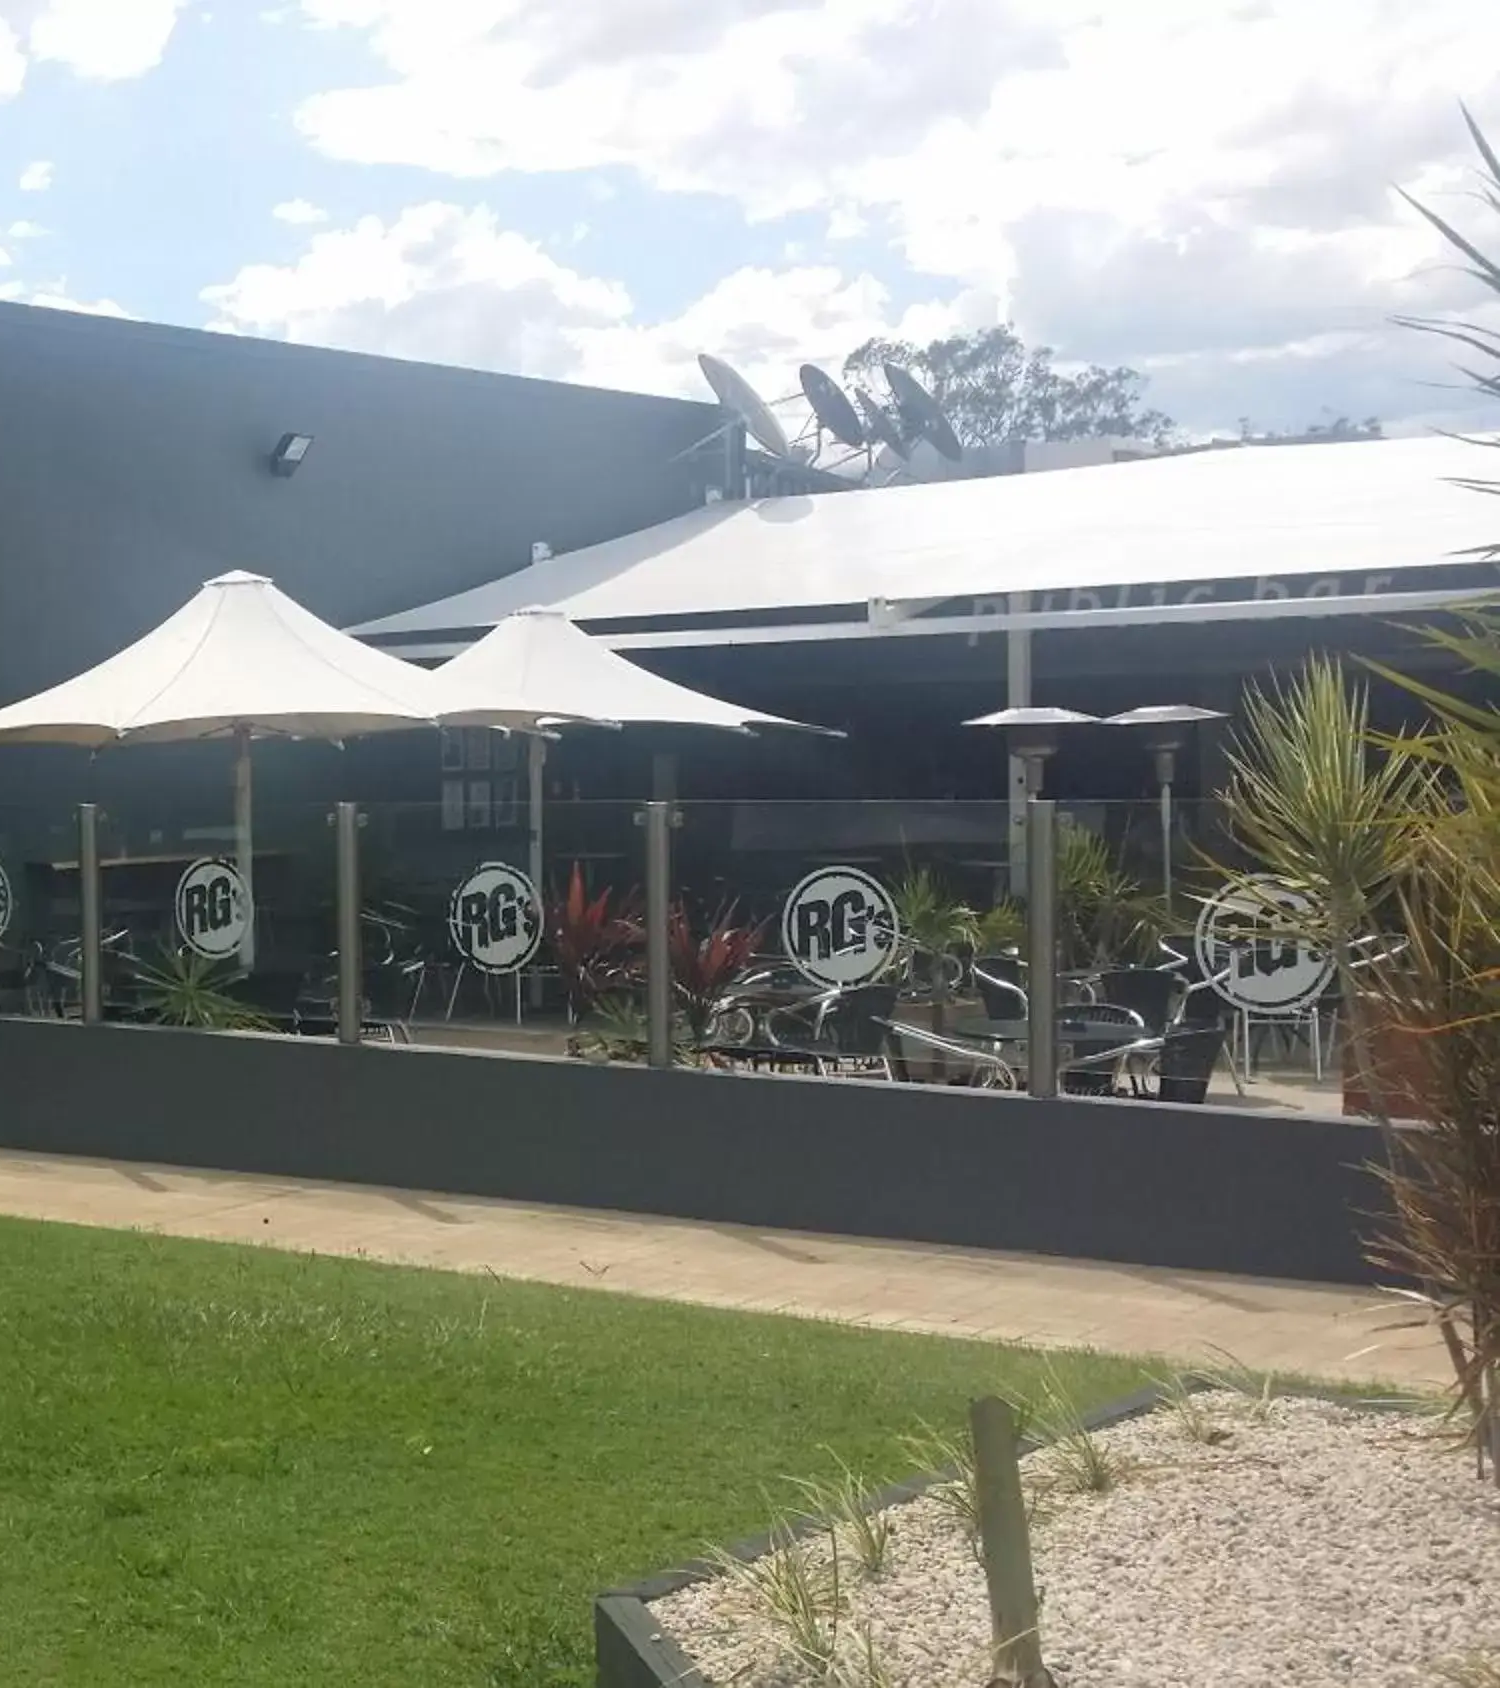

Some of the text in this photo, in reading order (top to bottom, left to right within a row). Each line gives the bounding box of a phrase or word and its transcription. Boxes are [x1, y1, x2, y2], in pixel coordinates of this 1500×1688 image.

[968, 580, 1215, 646] pblic
[461, 883, 537, 952] RG's
[797, 890, 891, 963] RG's
